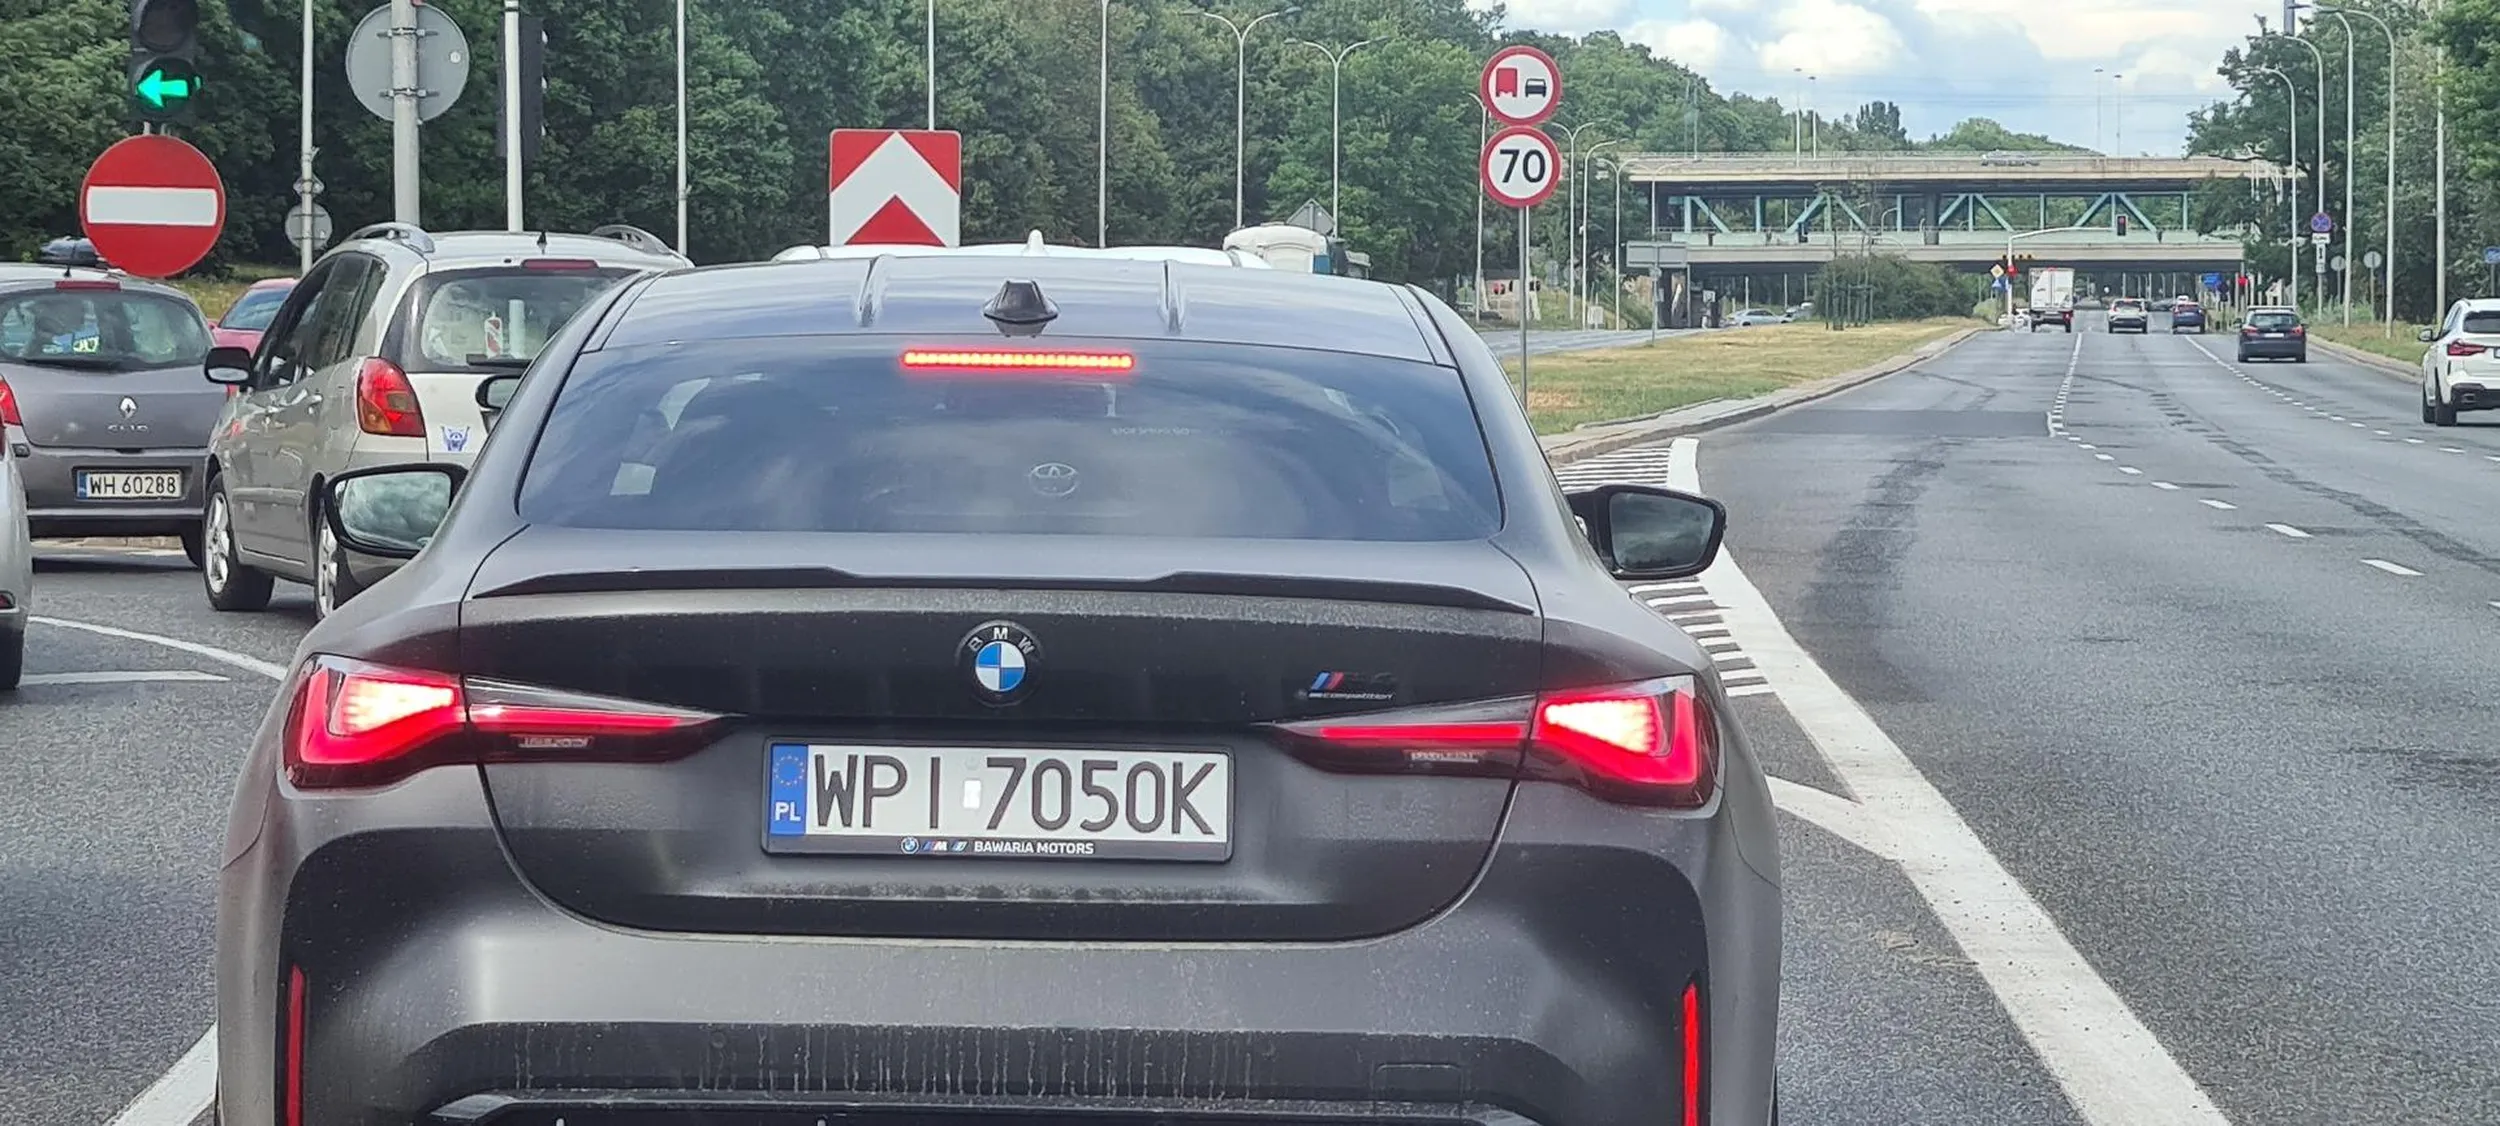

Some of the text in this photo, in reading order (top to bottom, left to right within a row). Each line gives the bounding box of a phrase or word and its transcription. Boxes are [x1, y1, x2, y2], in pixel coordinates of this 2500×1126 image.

[1500, 149, 1546, 183] 70
[90, 475, 176, 495] WH 60288
[967, 626, 1036, 655] BMW
[814, 754, 1217, 836] WPI 7050K
[774, 801, 802, 822] PL
[973, 840, 1034, 854] BAWARIA
[1036, 842, 1095, 855] MOTORS
